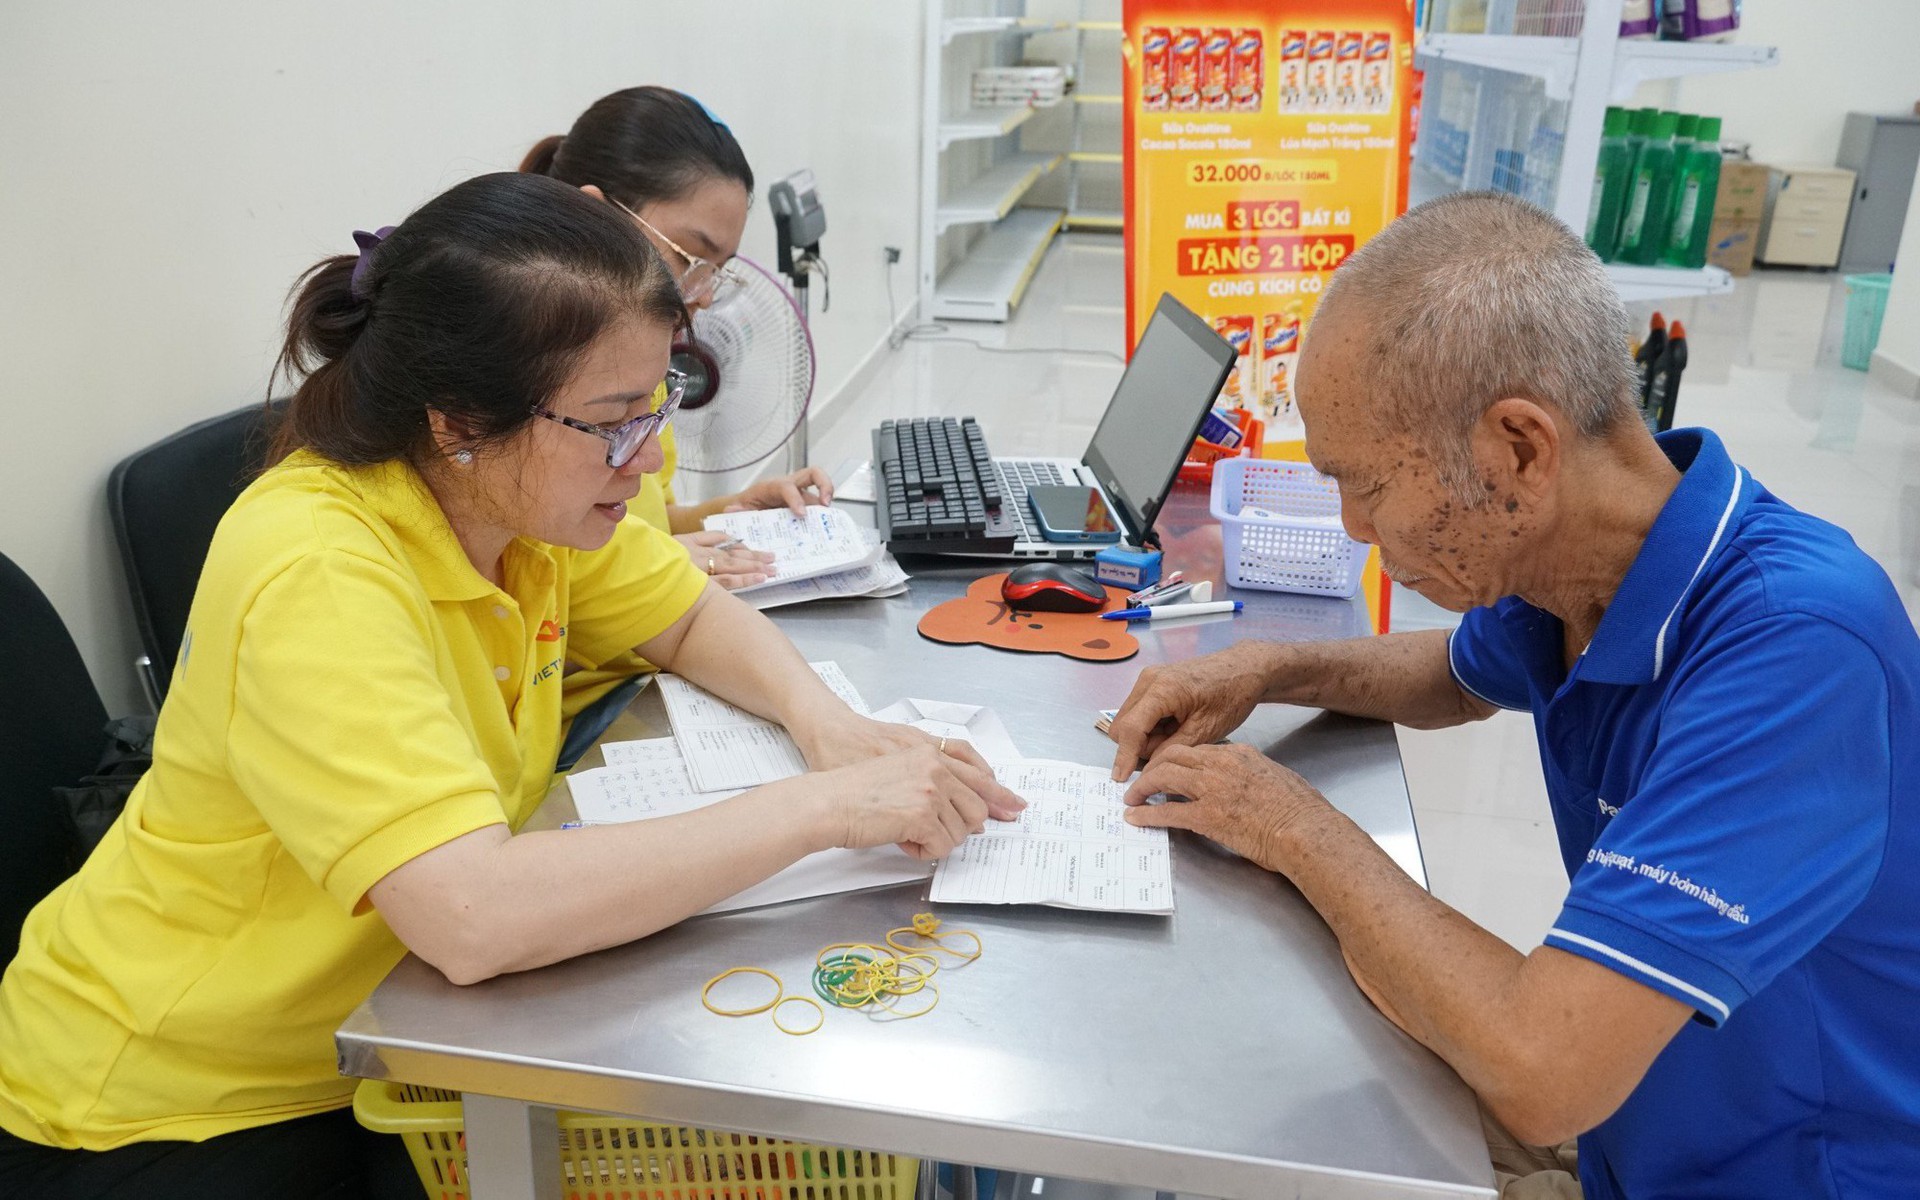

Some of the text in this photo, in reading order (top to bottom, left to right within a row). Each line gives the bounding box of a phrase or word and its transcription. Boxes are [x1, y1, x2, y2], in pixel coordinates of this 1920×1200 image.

[1193, 165, 1262, 183] 32.000
[1185, 201, 1351, 230] MUA 3 LỐC BẤT KÌ
[1188, 238, 1346, 275] TẶNG 2 HỘP
[1208, 279, 1255, 298] CÙNG
[1259, 276, 1296, 295] KÍCH
[1639, 864, 1670, 884] máy
[1669, 871, 1700, 898] bơm
[1699, 886, 1730, 916] hàng
